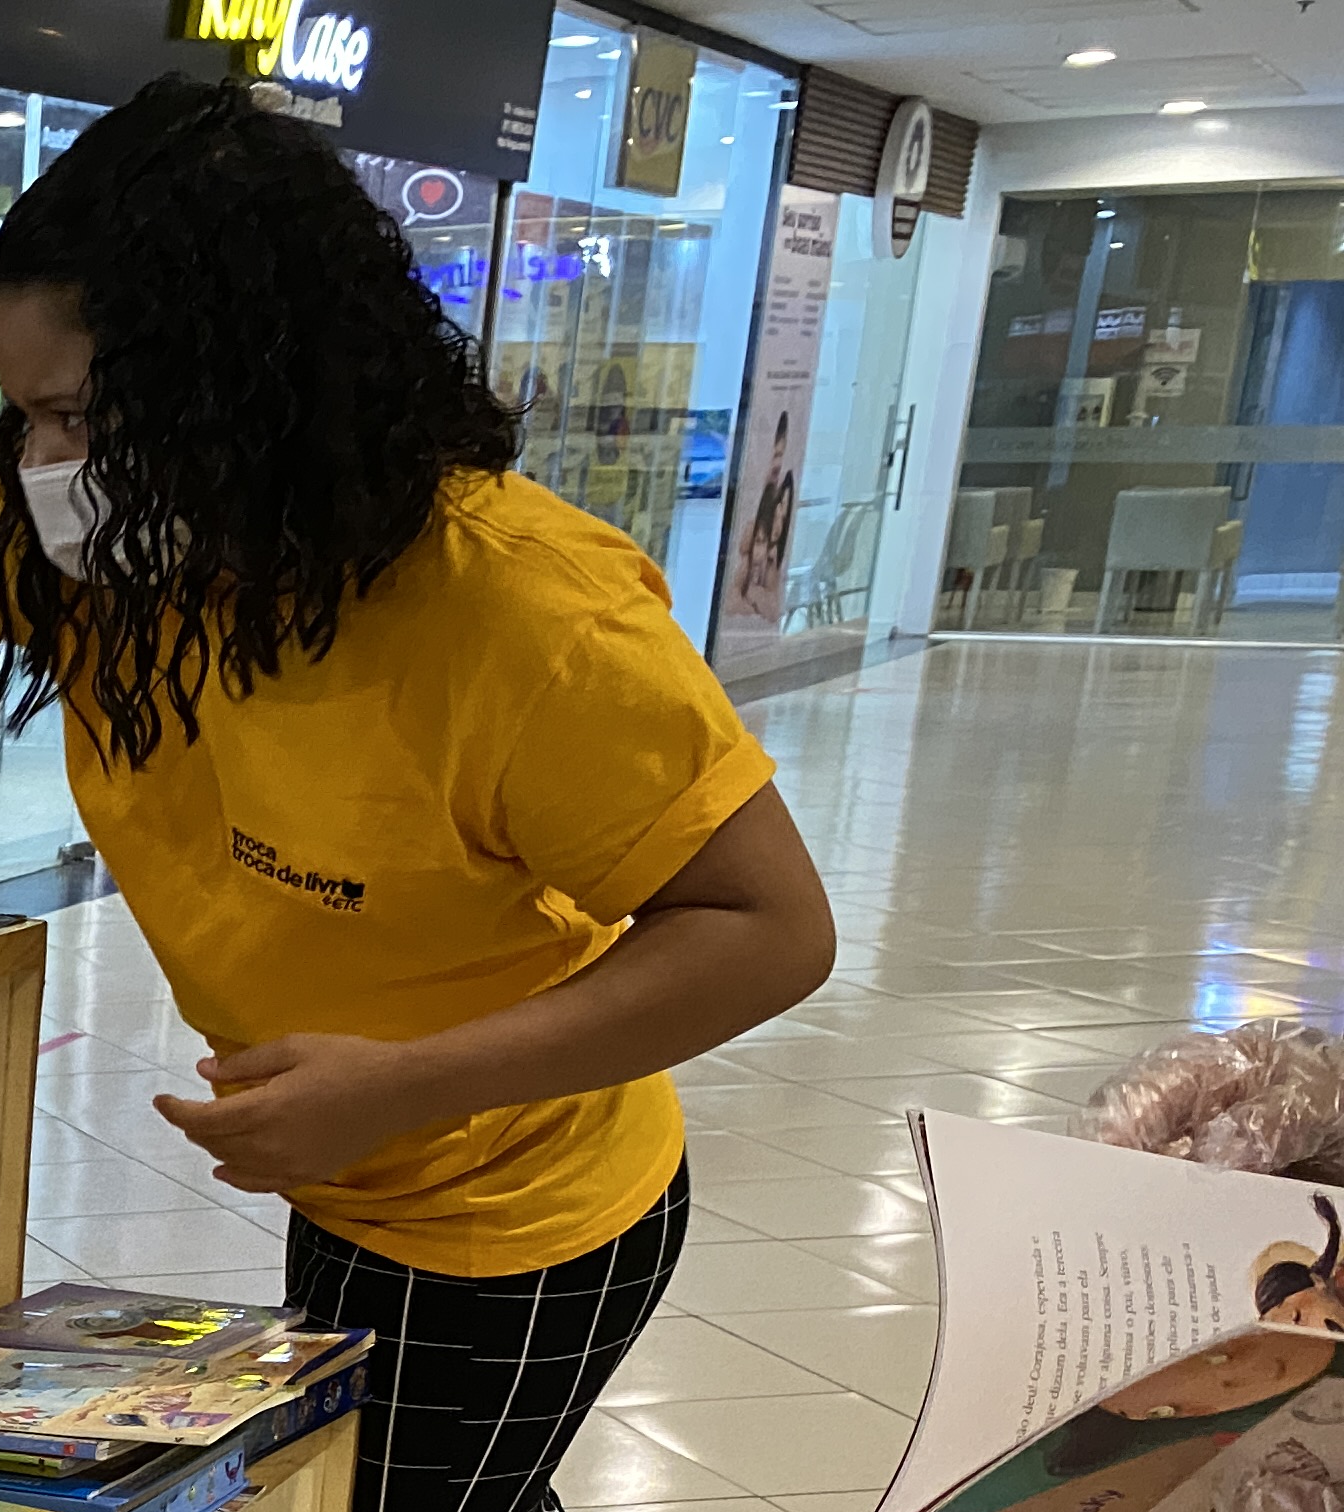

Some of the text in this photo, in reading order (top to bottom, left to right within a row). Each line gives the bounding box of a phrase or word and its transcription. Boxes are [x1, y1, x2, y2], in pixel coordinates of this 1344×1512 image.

[232, 826, 278, 861] troca
[232, 846, 303, 887] troca de
